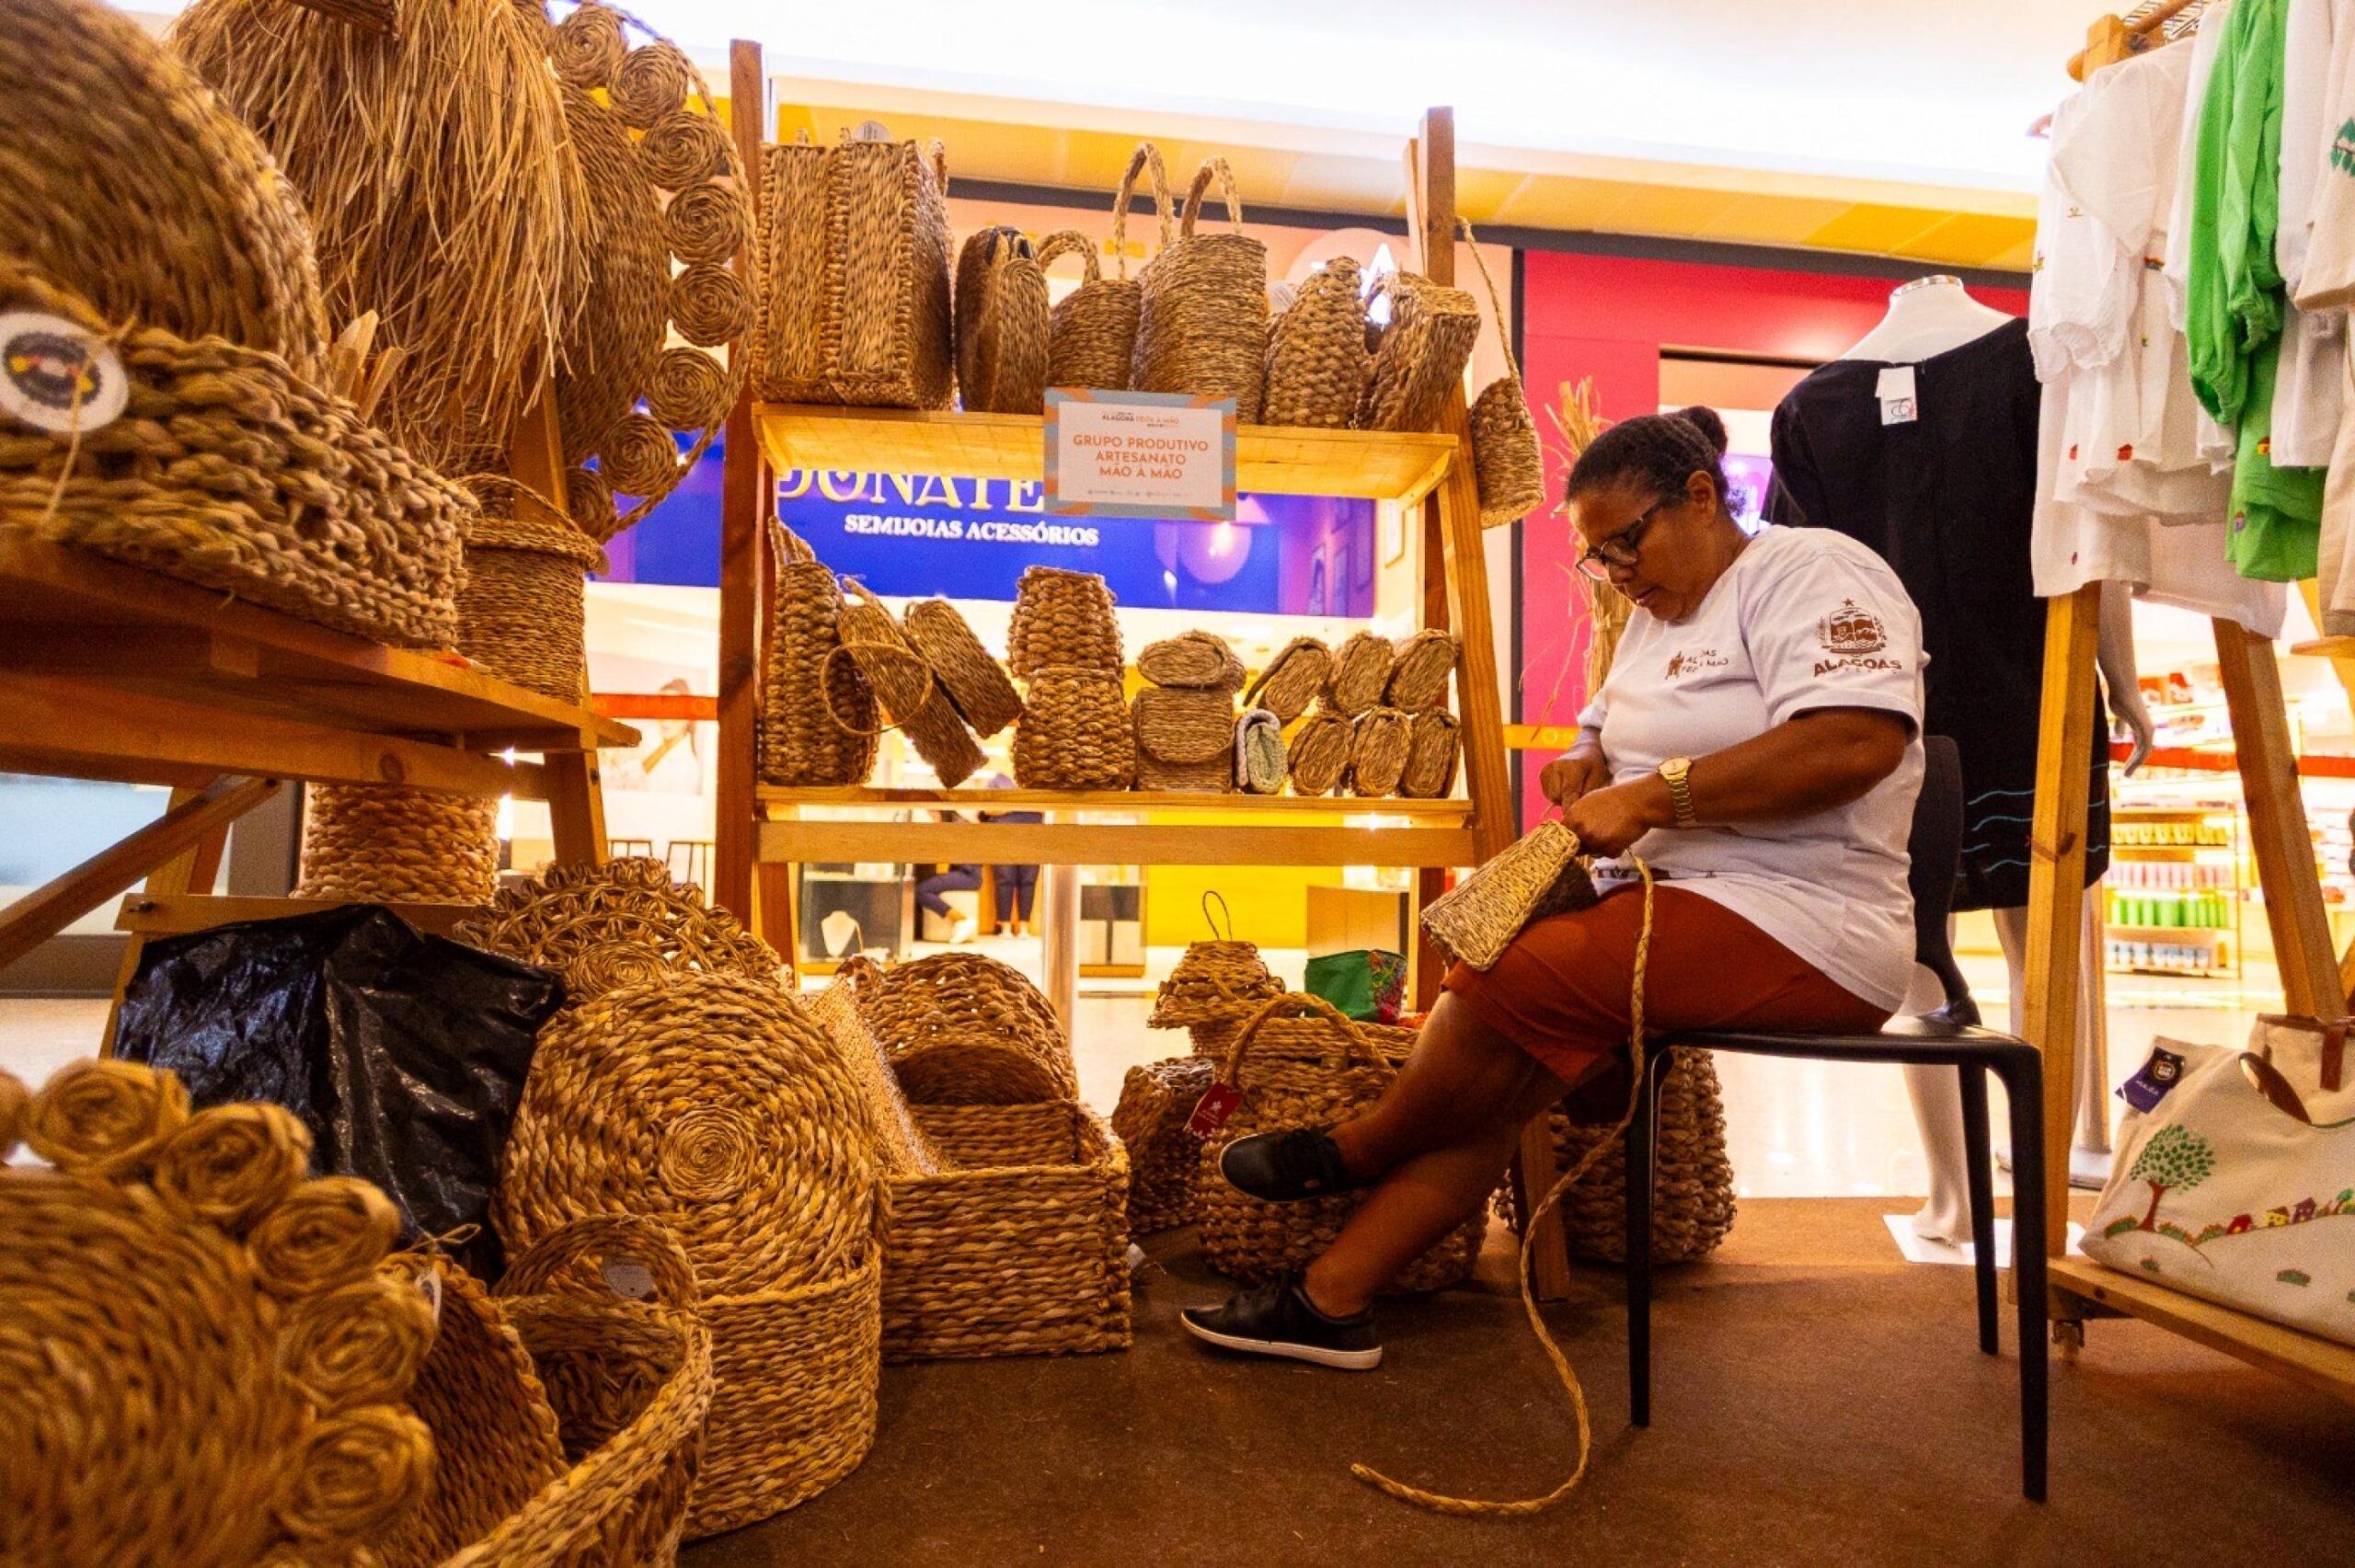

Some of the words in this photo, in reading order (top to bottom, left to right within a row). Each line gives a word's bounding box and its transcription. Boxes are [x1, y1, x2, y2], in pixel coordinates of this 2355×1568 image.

[1073, 434, 1122, 448] GRUPO
[1127, 437, 1209, 452] PRODUTIVO
[1095, 451, 1187, 465] ARTESANATO
[1099, 462, 1132, 478] MÃO
[1150, 464, 1183, 479] MÃO
[844, 514, 963, 539] SEMIJOIAS
[965, 521, 1099, 546] ACESSÓRIOS
[1813, 658, 1902, 677] ALAGOAS
